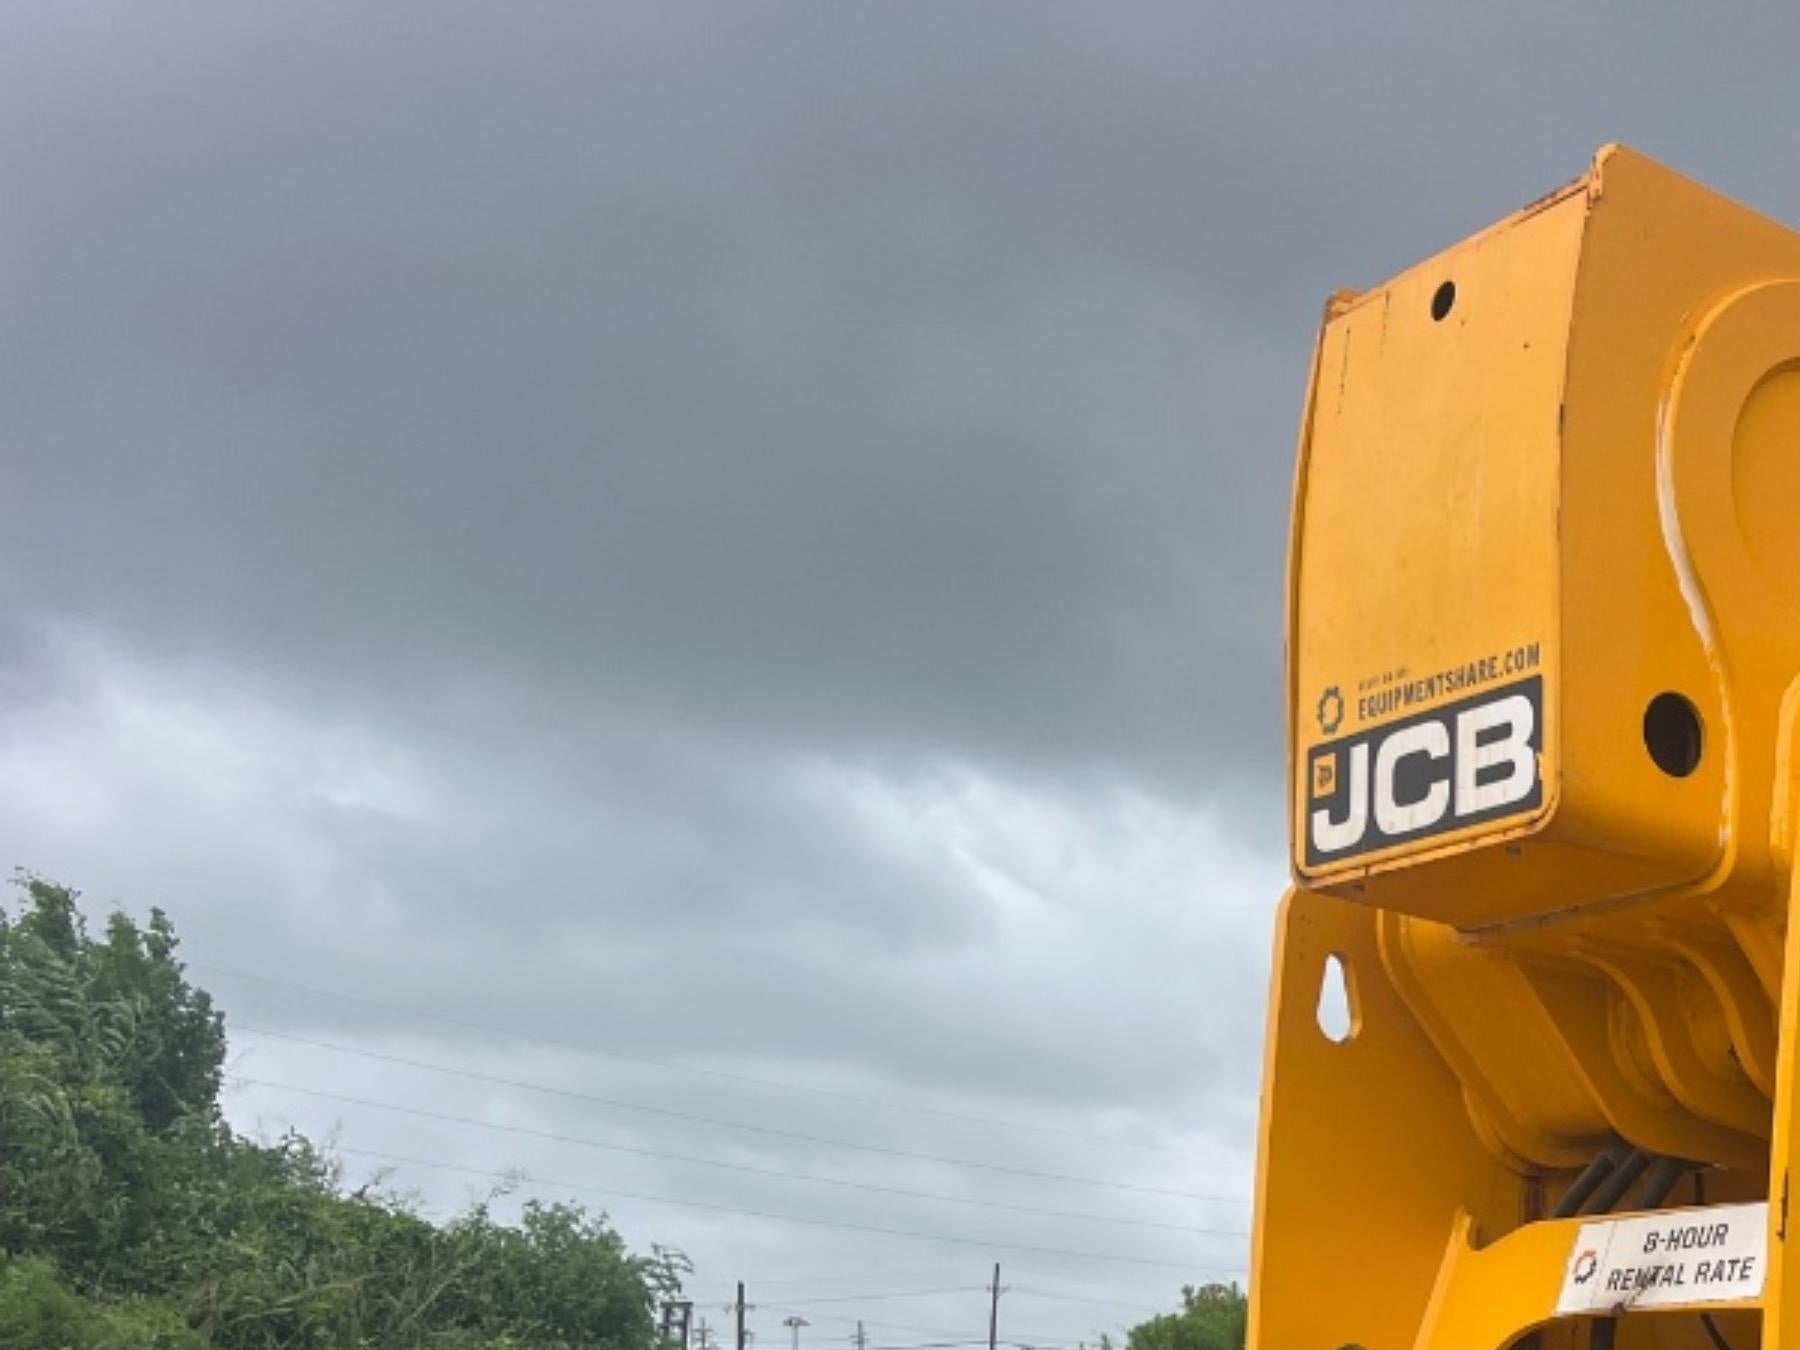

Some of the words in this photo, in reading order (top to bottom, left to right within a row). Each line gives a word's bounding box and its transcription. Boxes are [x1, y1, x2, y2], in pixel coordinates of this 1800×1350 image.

[1358, 642, 1541, 721] EQUIPMENTSHARE.COM
[1311, 693, 1536, 854] JCB
[1605, 1263, 1685, 1291] RENTAL
[1694, 1256, 1756, 1285] RATE
